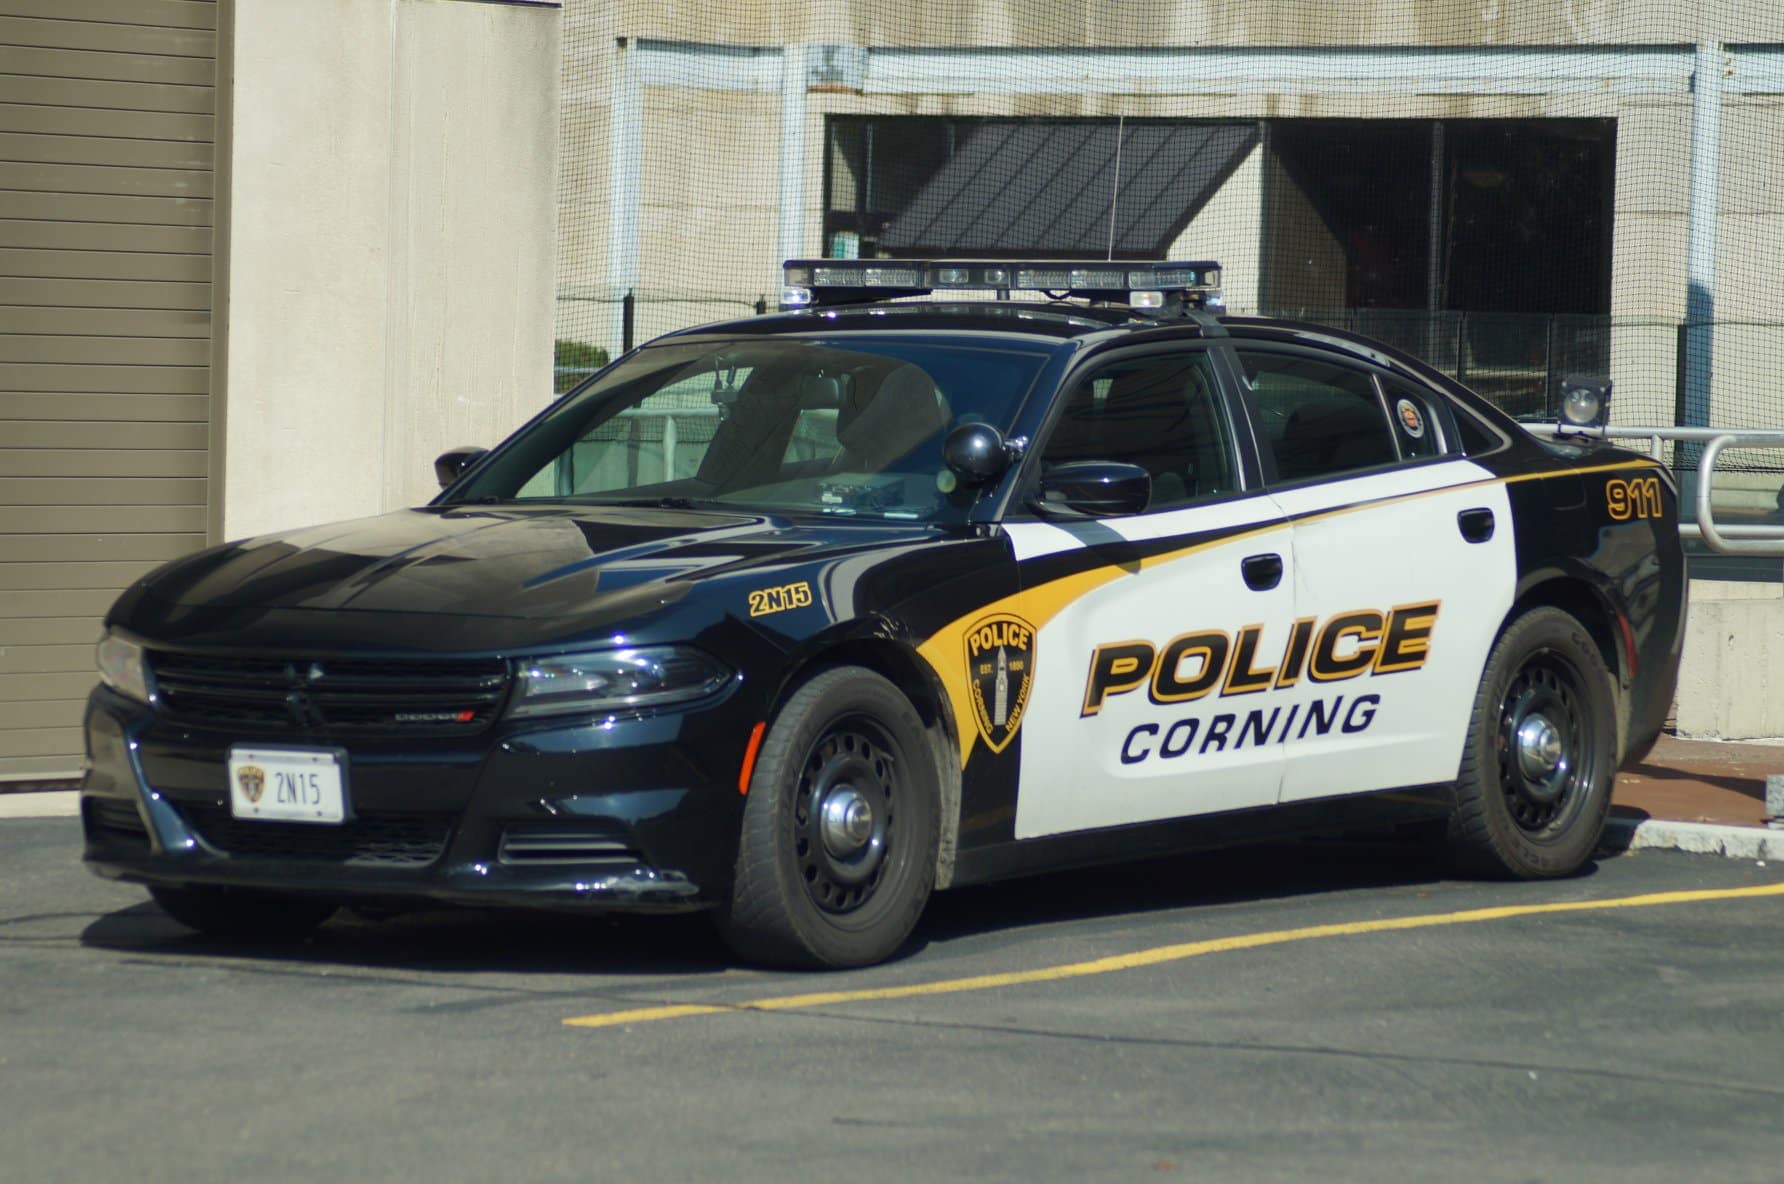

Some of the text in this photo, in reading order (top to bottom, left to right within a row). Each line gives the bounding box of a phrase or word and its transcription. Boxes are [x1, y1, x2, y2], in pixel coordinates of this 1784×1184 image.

[1606, 478, 1663, 521] 911
[748, 581, 813, 617] 2N15
[970, 623, 1028, 657] POLICE
[1080, 599, 1442, 718] POLICE
[1005, 673, 1030, 732] NEW YORK
[1120, 693, 1381, 765] CORNING
[275, 771, 321, 805] 2N15
